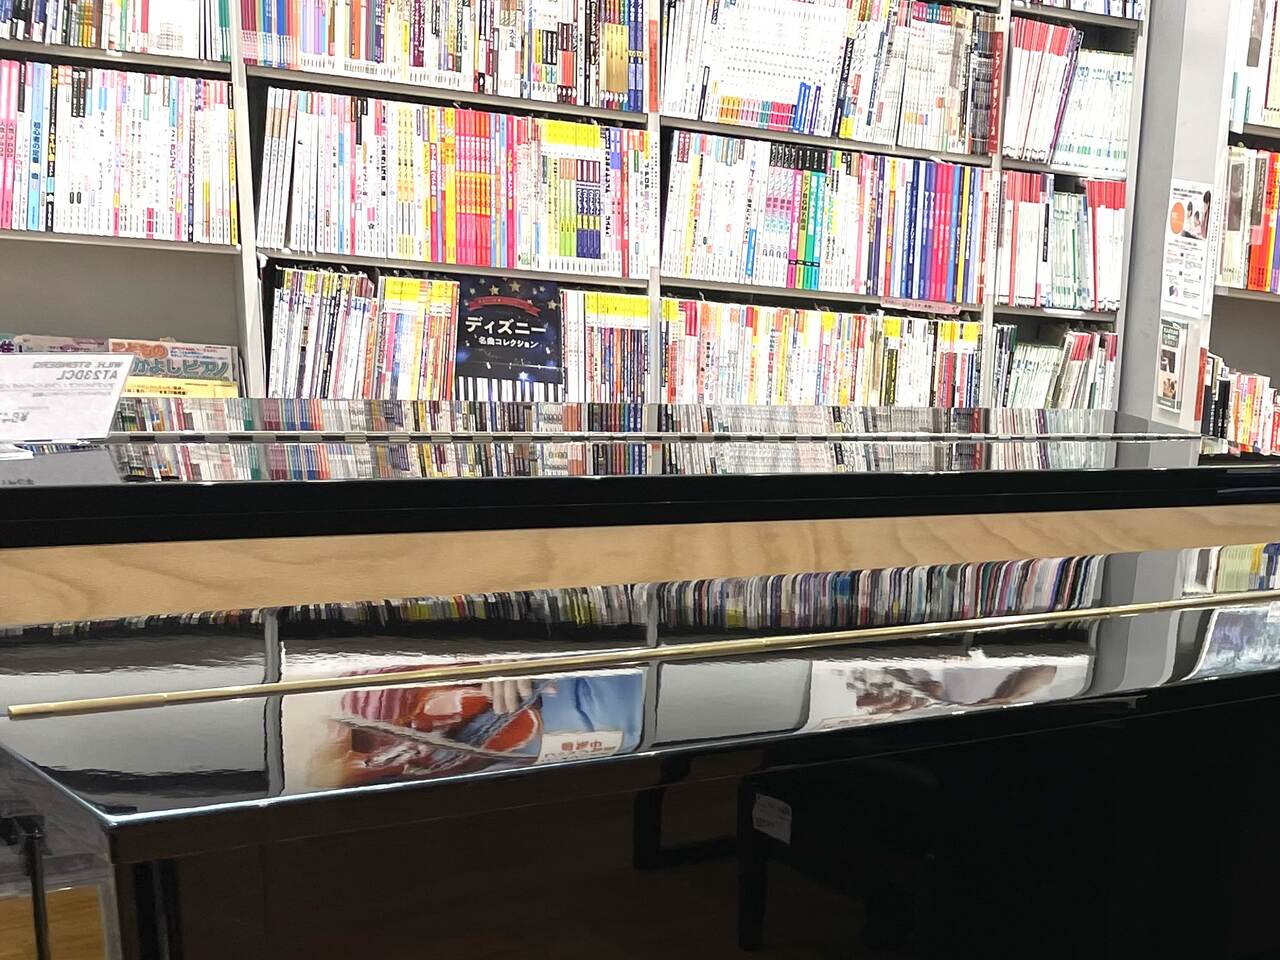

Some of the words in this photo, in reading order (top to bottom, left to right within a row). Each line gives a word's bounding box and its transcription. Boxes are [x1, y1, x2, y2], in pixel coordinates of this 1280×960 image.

[465, 316, 546, 335] ディズニー
[479, 336, 539, 349] 名曲コレクション
[131, 359, 229, 377] かよしピアノ
